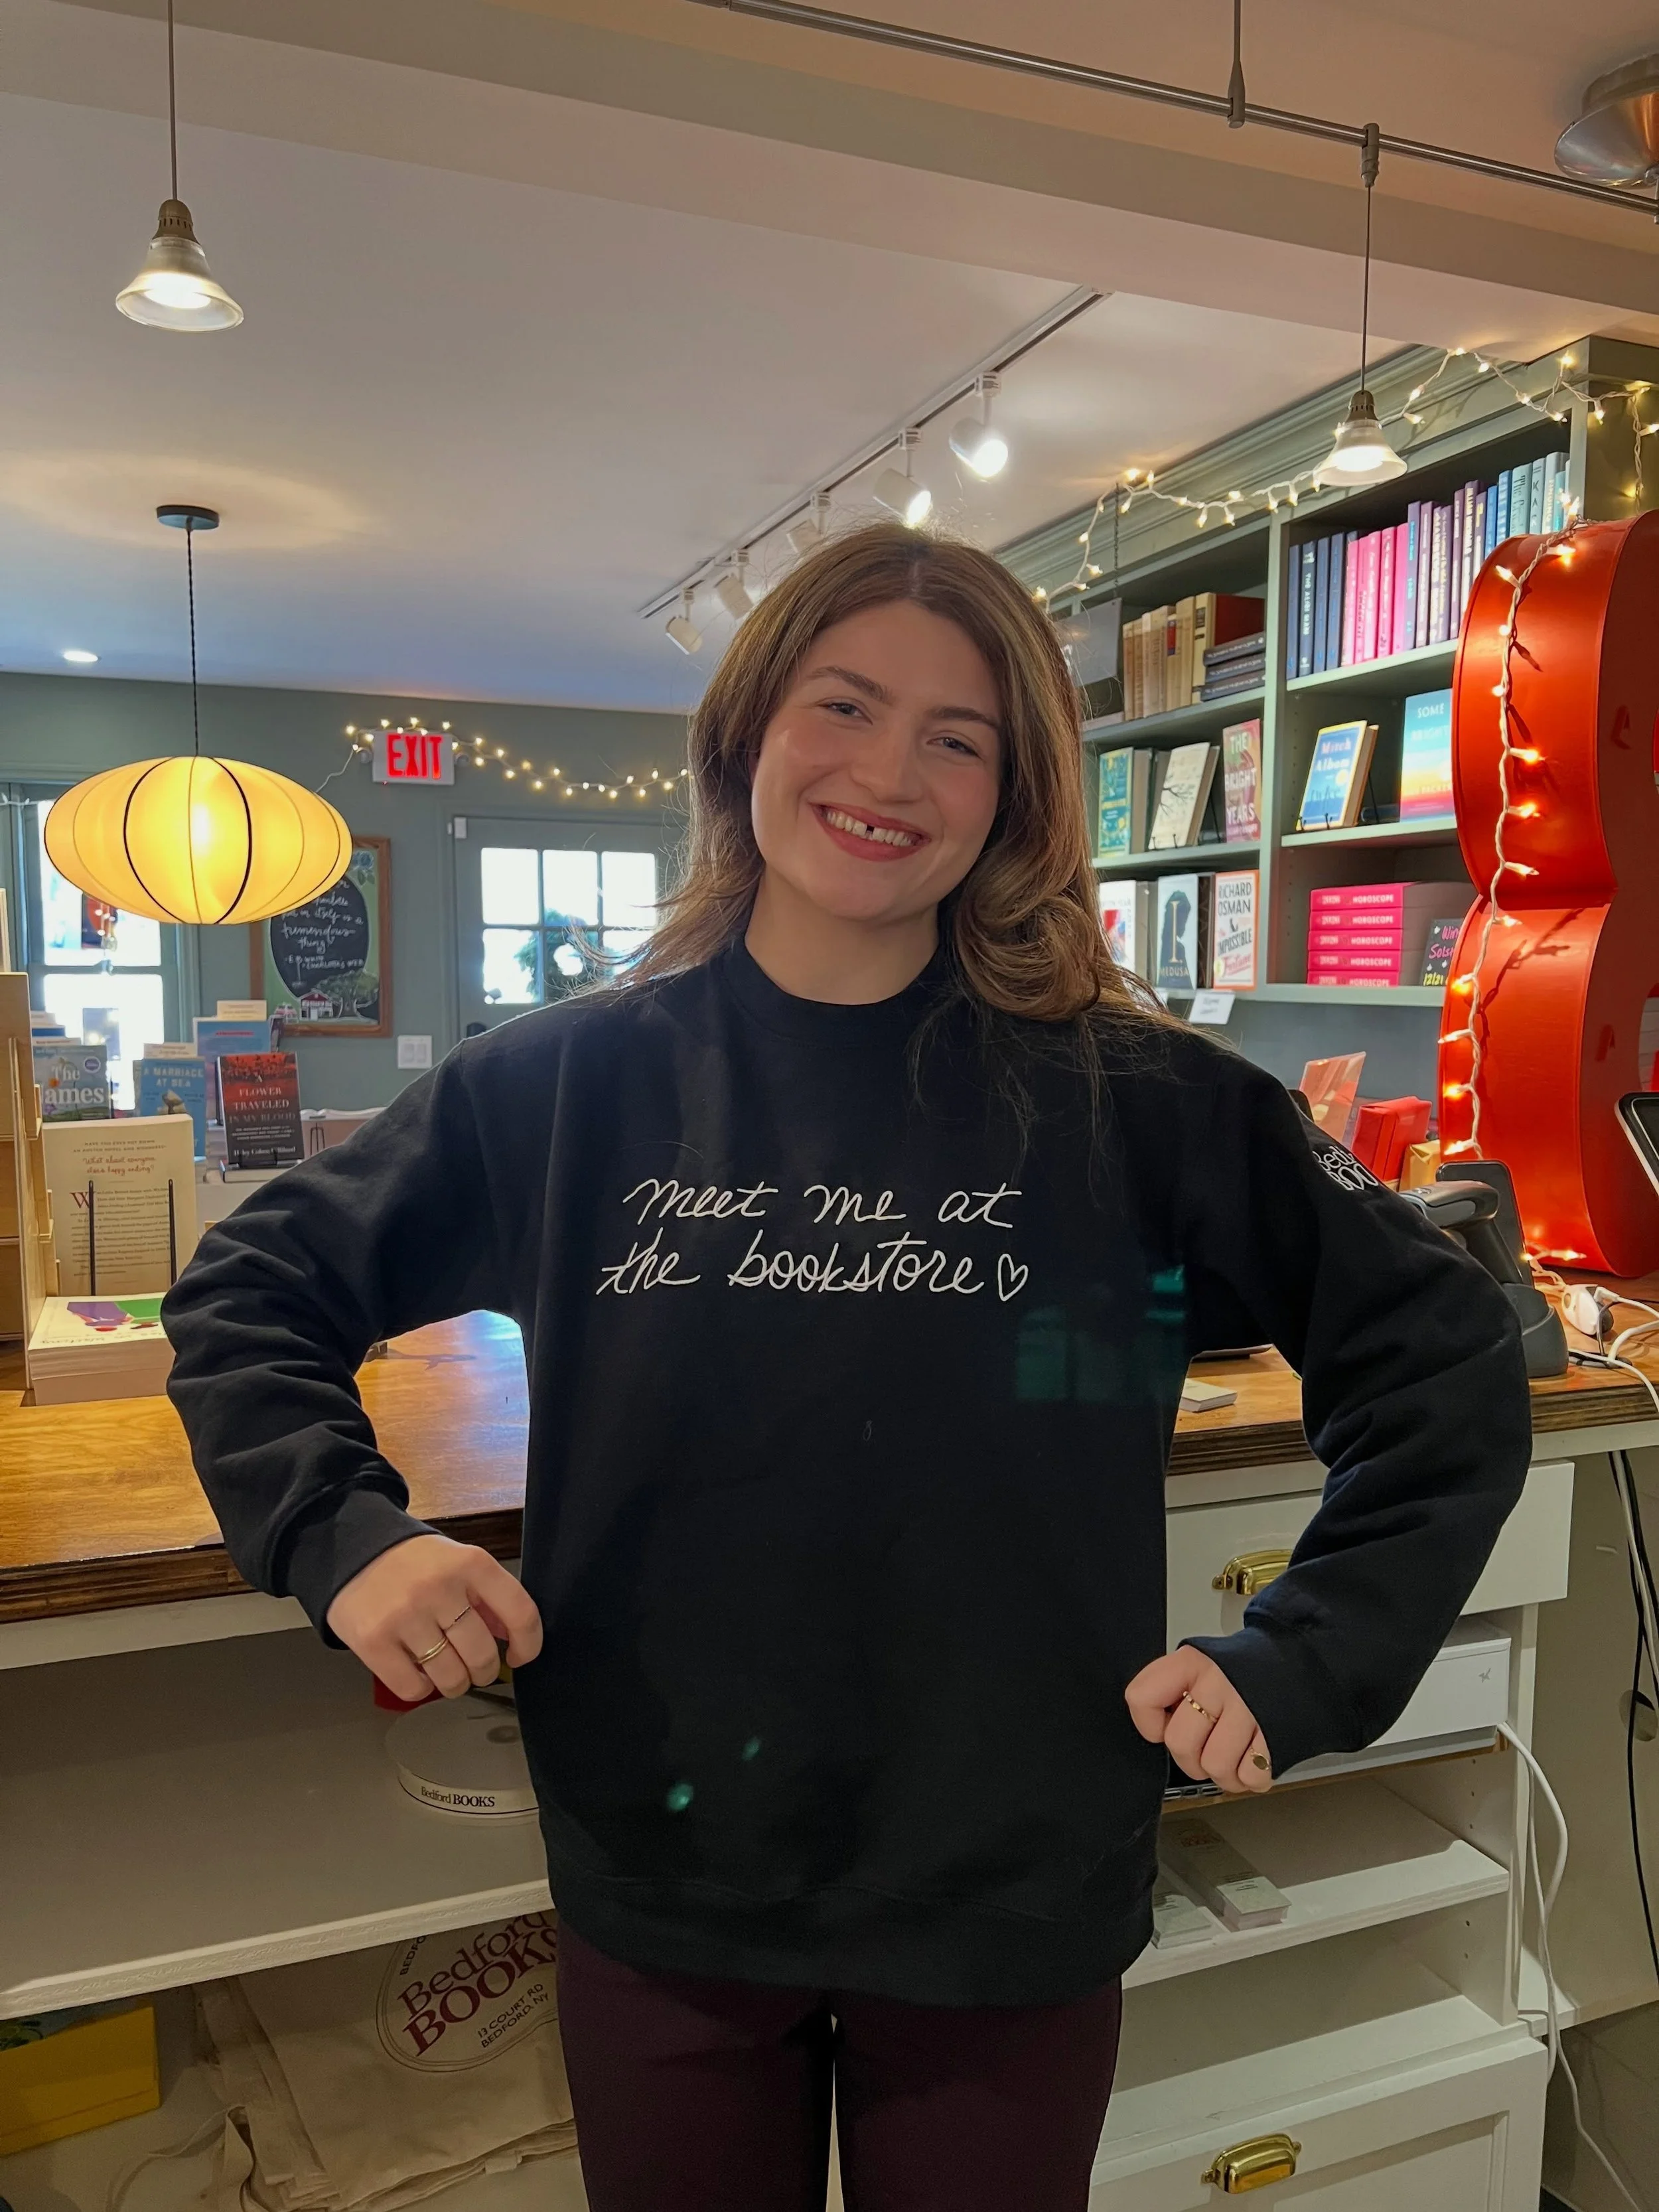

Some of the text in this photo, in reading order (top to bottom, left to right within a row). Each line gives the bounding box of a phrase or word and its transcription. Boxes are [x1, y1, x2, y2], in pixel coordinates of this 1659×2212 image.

[1417, 703, 1444, 719] SOME
[1230, 732, 1249, 754] THE
[1321, 738, 1351, 754] Mitch
[387, 733, 443, 780] EXIT
[1316, 757, 1350, 771] Albom
[1224, 767, 1257, 792] BRIGHT
[1227, 804, 1256, 825] YEARS
[1218, 881, 1252, 898] RICHARD
[1218, 899, 1252, 916] OSMAN
[1217, 929, 1252, 956] IMPOSSIBLE
[1160, 966, 1189, 978] MEDUSA
[52, 1066, 81, 1082] The
[155, 1078, 167, 1087] AT
[256, 1074, 263, 1083] A
[41, 1088, 105, 1106] ames
[239, 1086, 282, 1096] FLOWER
[233, 1098, 290, 1111] TRAVELED
[803, 1183, 907, 1225] me
[937, 1182, 1023, 1228] at
[596, 1226, 985, 1295] the bookstore
[421, 1785, 495, 1808] Bedford BOOKS
[397, 1910, 552, 2021] Bedford
[533, 1992, 549, 2006] NY
[477, 1984, 544, 2038] 13 COURT RD
